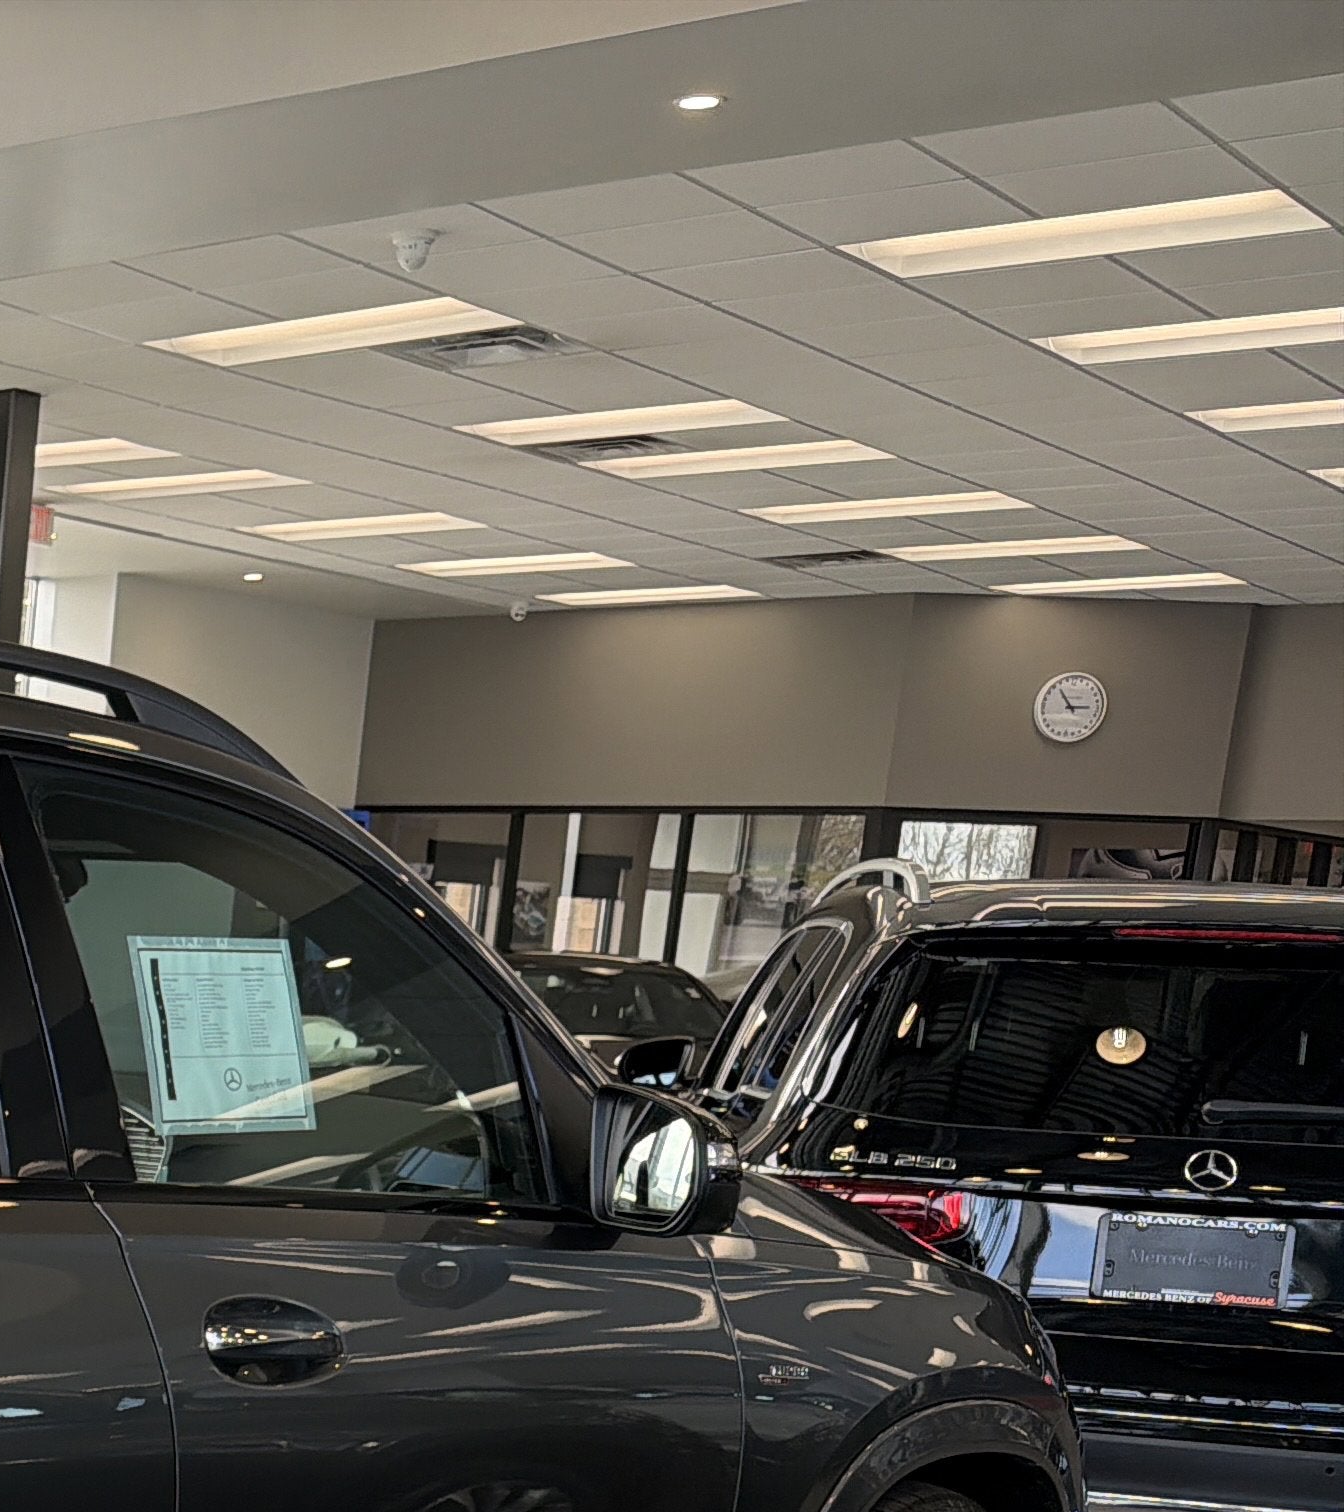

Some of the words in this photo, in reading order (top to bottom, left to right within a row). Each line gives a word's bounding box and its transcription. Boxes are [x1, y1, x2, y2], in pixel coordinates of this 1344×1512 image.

[830, 1147, 889, 1165] GLB
[894, 1153, 957, 1171] 250
[1111, 1212, 1287, 1232] ROMANOCARS.COM
[1102, 1288, 1162, 1302] MERCEDES
[1164, 1293, 1196, 1304] BENZ
[1214, 1290, 1278, 1307] Syracuse
